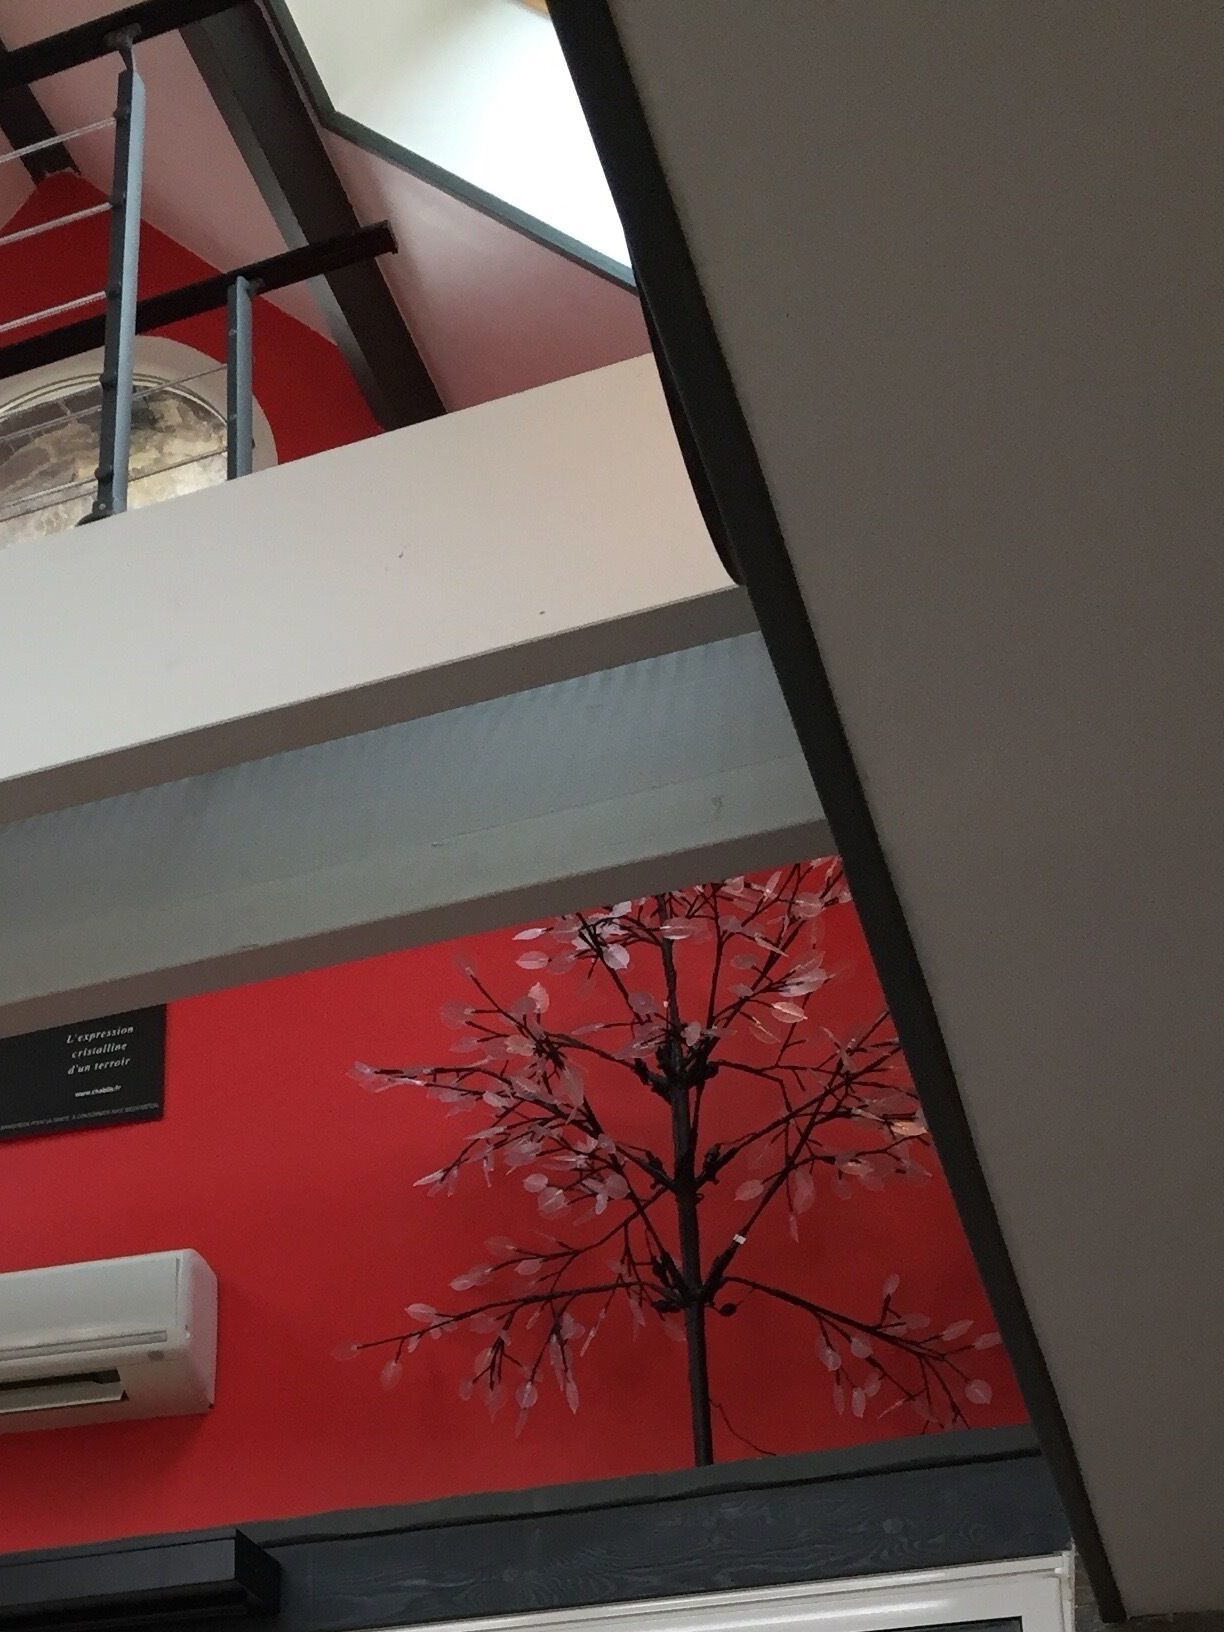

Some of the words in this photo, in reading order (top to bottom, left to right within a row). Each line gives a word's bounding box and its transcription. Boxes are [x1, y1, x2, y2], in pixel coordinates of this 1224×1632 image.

[66, 1026, 134, 1044] L'expression
[71, 1043, 128, 1059] cristalline
[67, 1064, 90, 1075] d'un
[94, 1057, 131, 1071] terroir
